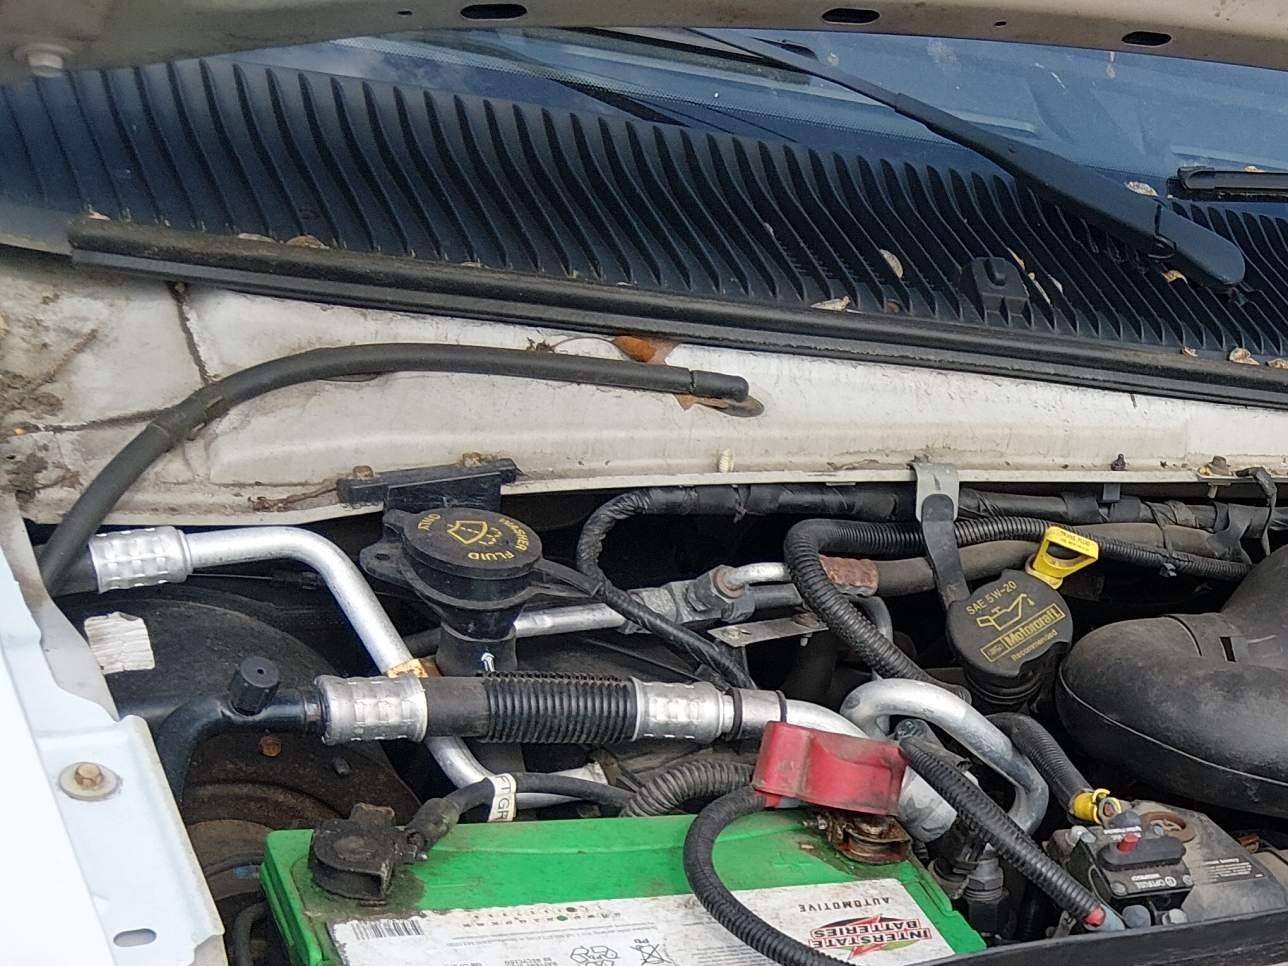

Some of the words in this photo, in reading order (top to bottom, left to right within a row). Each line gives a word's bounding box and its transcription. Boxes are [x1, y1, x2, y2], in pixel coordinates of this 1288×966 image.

[418, 513, 441, 531] ONLY
[499, 517, 529, 552] WASHER
[468, 550, 515, 561] FLUID
[966, 599, 987, 615] SAE
[986, 580, 1017, 604] 5W-20
[1003, 607, 1062, 646] Motorcraft
[1011, 628, 1058, 661] Recommended
[798, 897, 889, 912] AUTOMOTIVE
[808, 928, 931, 949] INTERSTATE
[811, 920, 920, 939] BATTERIES
